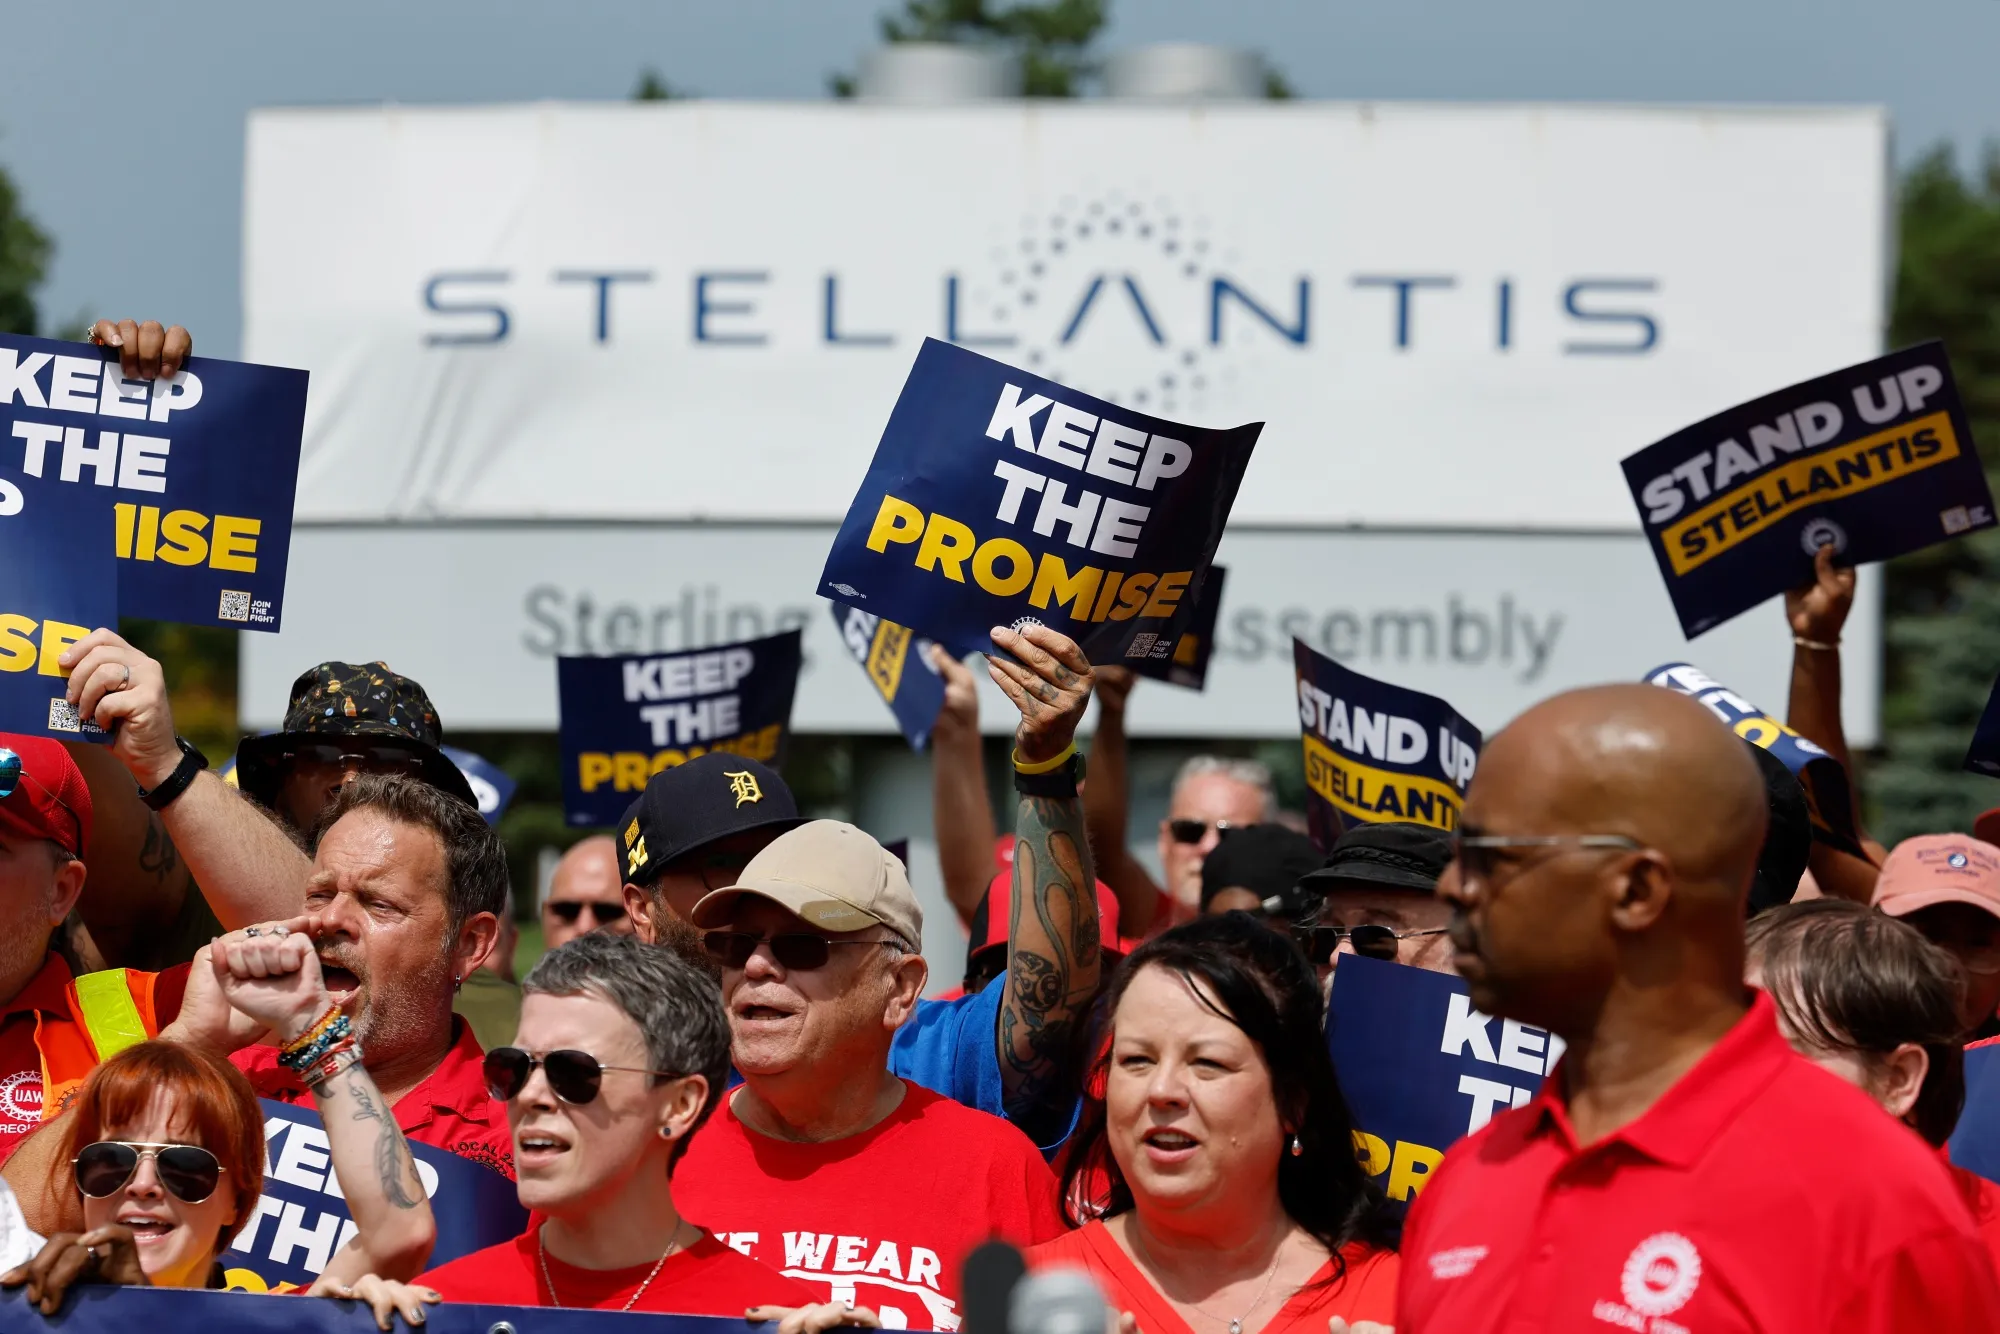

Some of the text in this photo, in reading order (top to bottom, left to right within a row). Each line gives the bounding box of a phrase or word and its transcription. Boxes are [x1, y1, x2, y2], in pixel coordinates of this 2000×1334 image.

[422, 270, 1663, 354] STELLANTIS
[0, 348, 203, 423] KEEP
[11, 420, 171, 494] THE
[985, 382, 1193, 491] KEEP
[1642, 364, 1944, 524] STAND UP
[993, 459, 1151, 558] THE
[1678, 427, 1943, 561] STELLANTIS
[866, 494, 1193, 624] PROMISE
[249, 614, 275, 624] FIGHT
[250, 607, 268, 615] THE
[251, 600, 271, 608] JOIN
[1214, 592, 1566, 686] ssembly
[622, 647, 756, 702] KEEP
[81, 724, 107, 734] FIGH
[640, 694, 740, 746] THE
[1299, 678, 1477, 789] STAND UP
[14, 1089, 43, 1104] UAW
[449, 1141, 498, 1157] LOCAL
[231, 1193, 360, 1276] TH
[783, 1231, 942, 1291] WEAR
